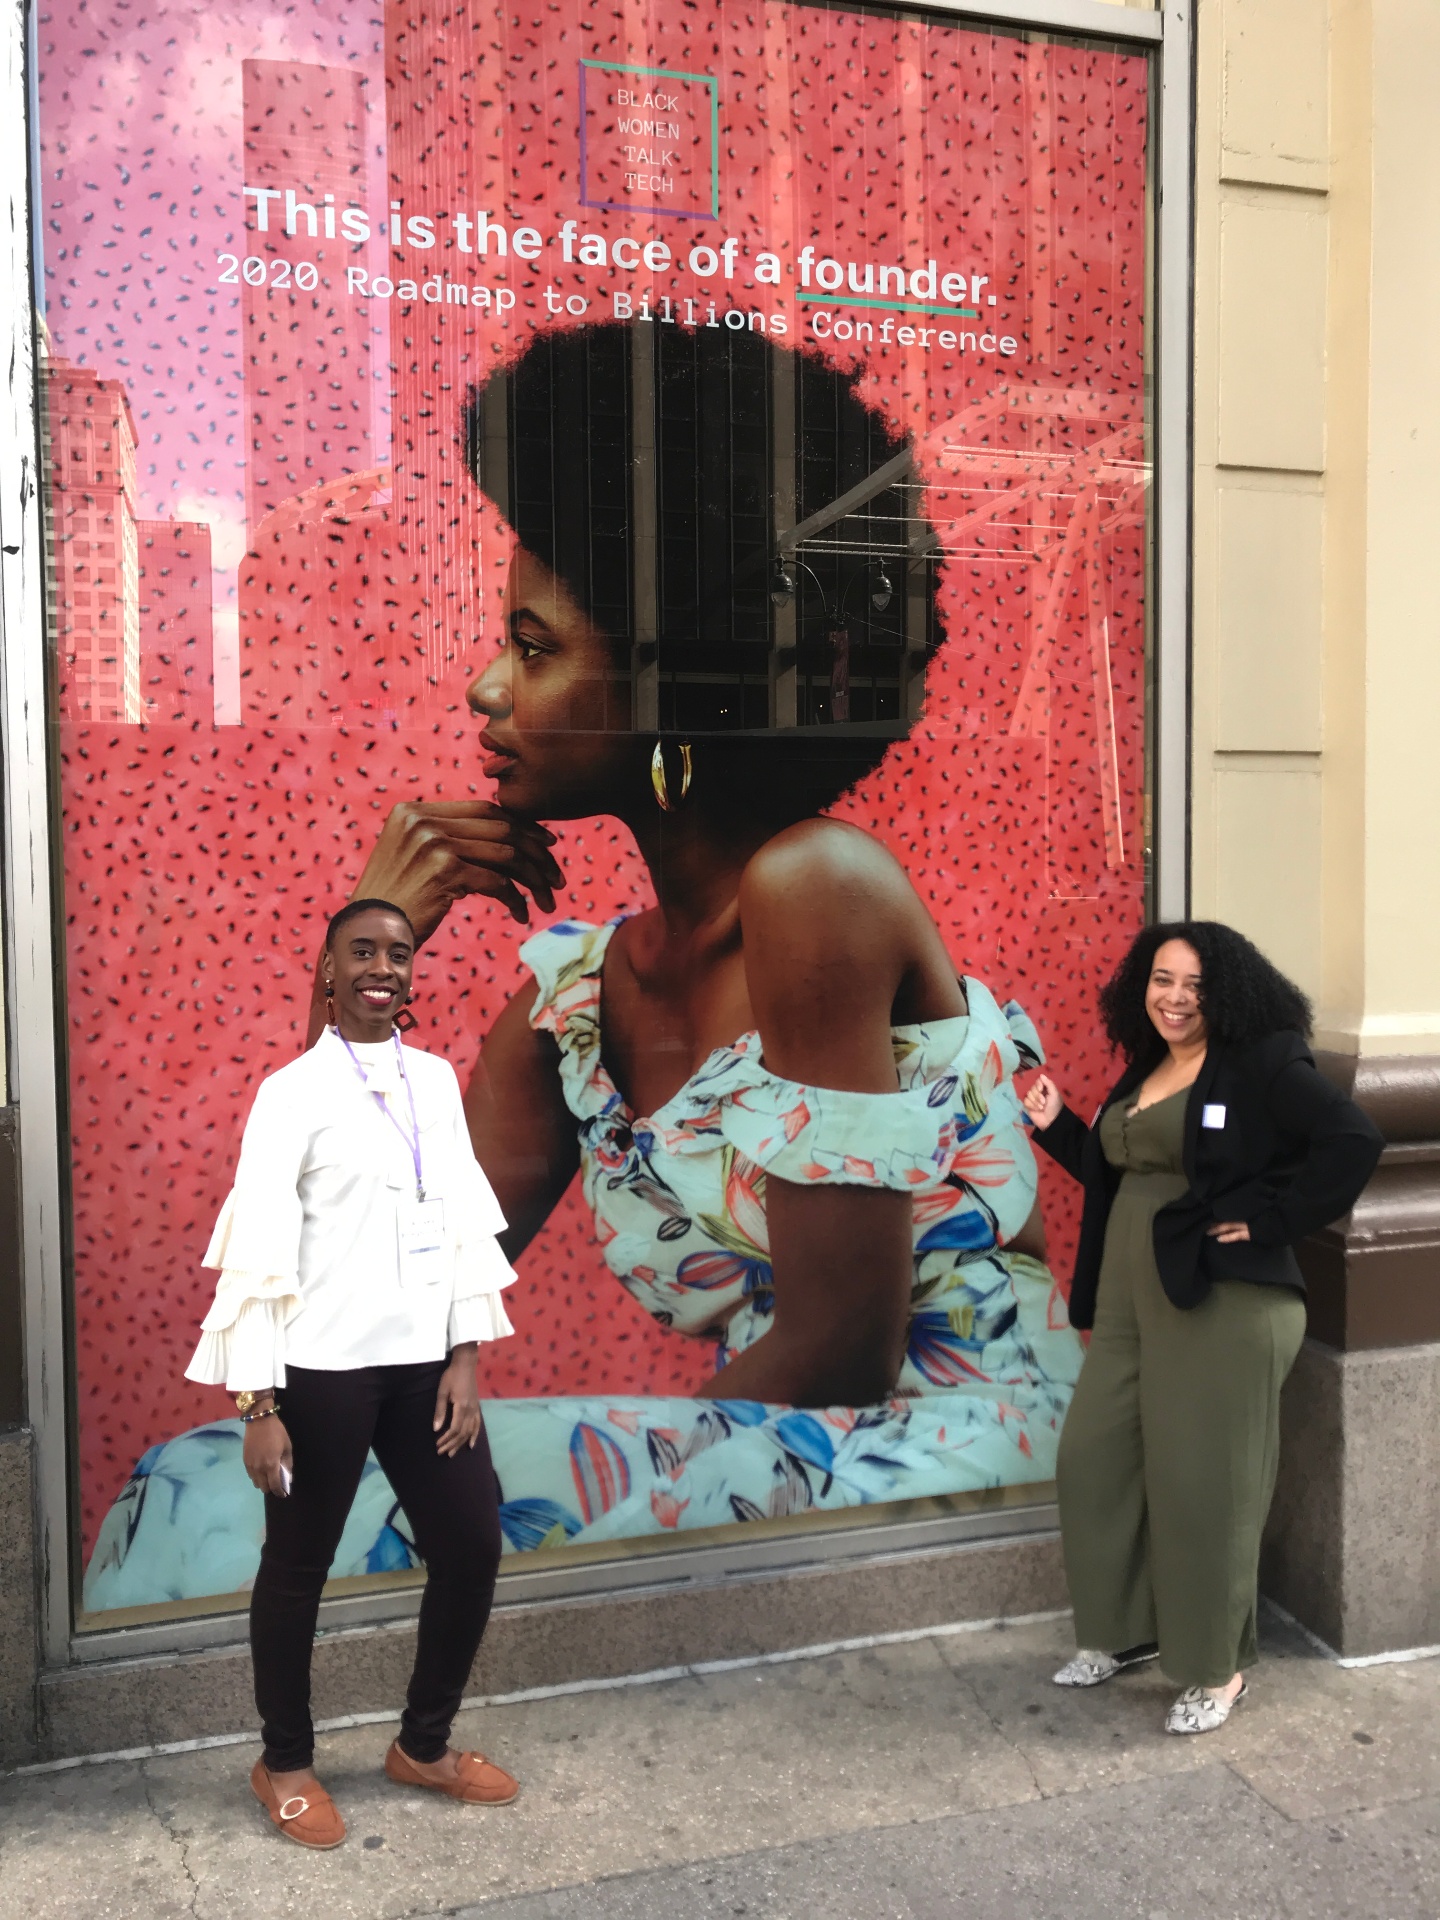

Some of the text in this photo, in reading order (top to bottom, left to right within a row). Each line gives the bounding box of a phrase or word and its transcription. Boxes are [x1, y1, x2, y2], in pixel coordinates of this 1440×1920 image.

[617, 89, 679, 112] BLACK
[618, 117, 680, 140] WOMEN
[624, 145, 673, 167] TALK
[624, 173, 674, 194] TECH
[243, 187, 997, 306] This is the face of a founder.
[216, 253, 1018, 355] 2020 Roadmap to Billions Conference
